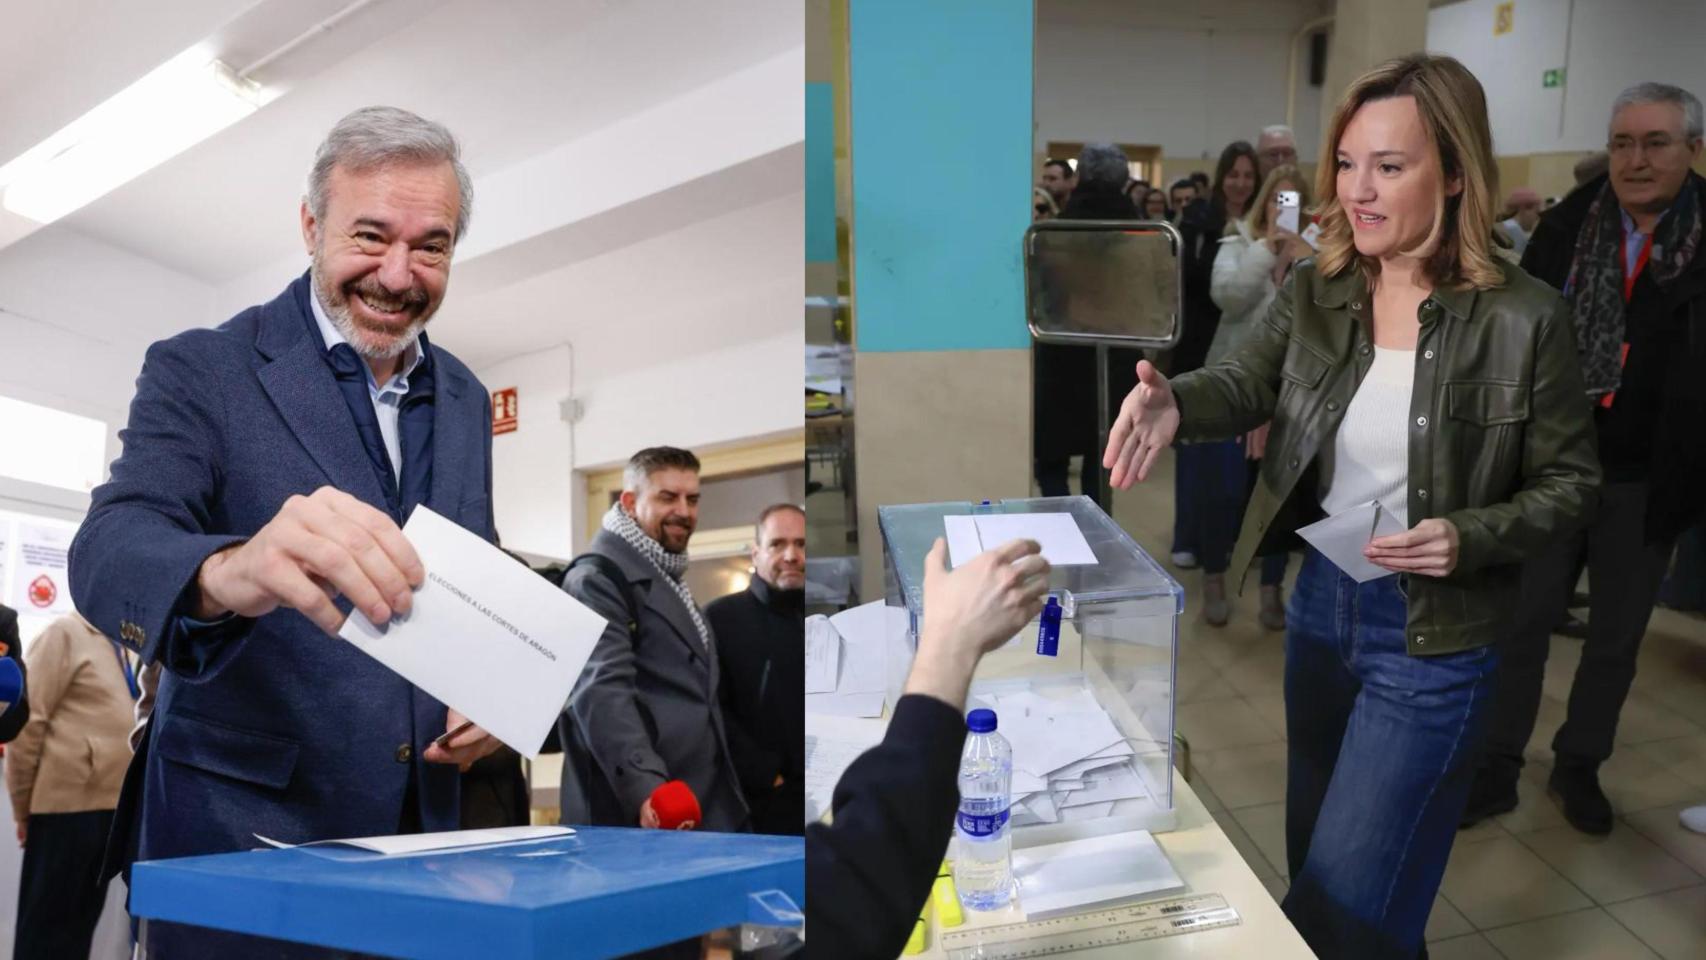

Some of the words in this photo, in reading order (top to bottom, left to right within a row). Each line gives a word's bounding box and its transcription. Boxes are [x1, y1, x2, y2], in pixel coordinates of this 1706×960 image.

[428, 572, 471, 603] ELECCIONES
[478, 604, 492, 617] LAS
[491, 614, 519, 636] CORTES
[518, 632, 529, 643] DE
[529, 639, 557, 661] ARAGÓN
